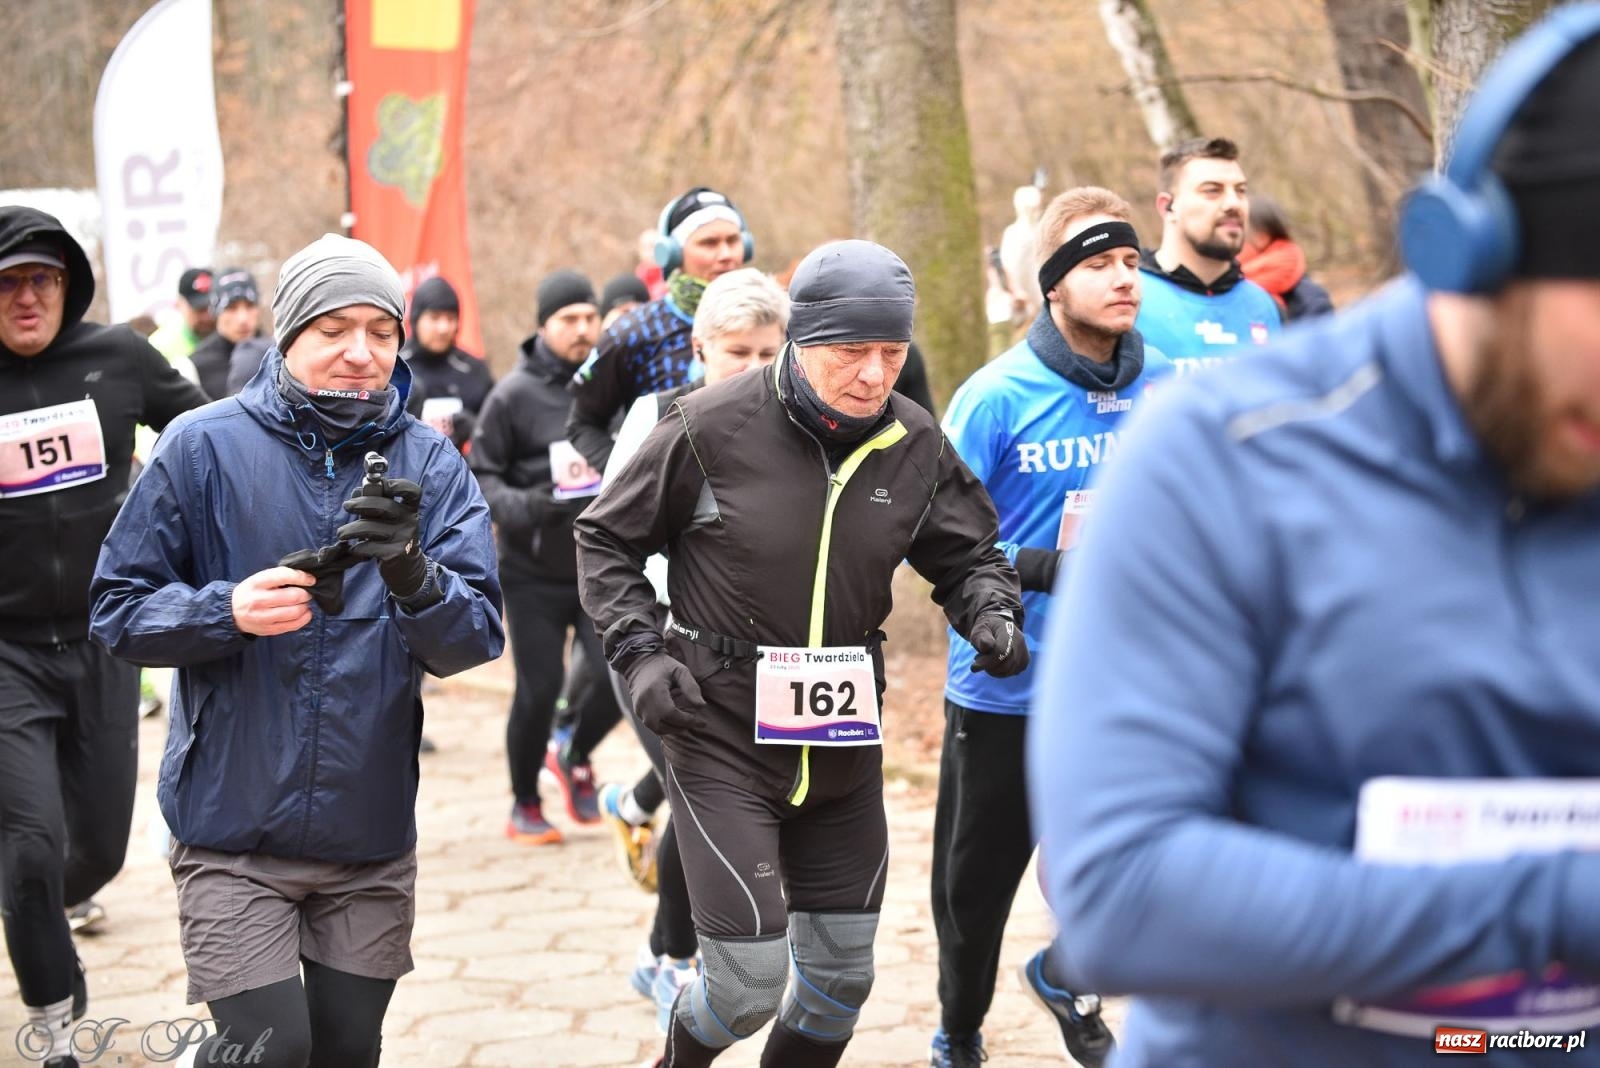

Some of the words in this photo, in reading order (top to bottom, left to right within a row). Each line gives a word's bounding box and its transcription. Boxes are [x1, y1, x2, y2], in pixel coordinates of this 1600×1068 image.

[19, 434, 73, 470] 151
[1016, 431, 1123, 474] RUNN
[671, 621, 699, 640] alenji
[770, 652, 801, 663] BIEG
[790, 680, 858, 717] 162
